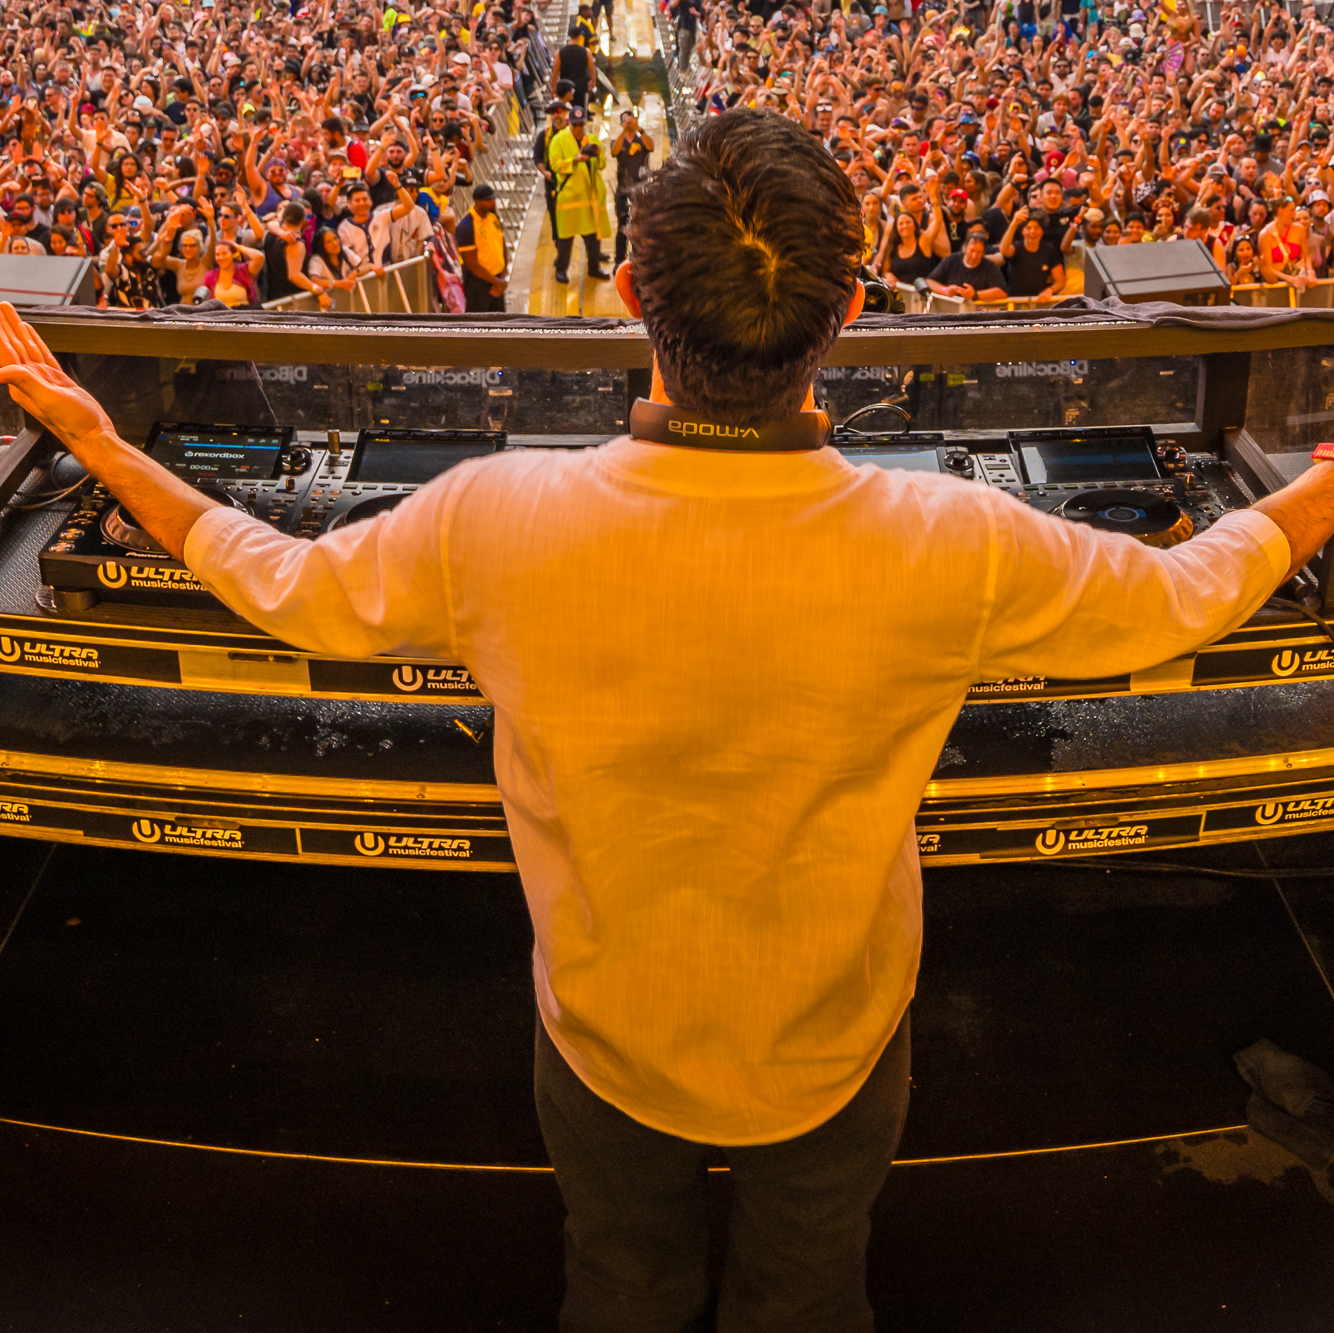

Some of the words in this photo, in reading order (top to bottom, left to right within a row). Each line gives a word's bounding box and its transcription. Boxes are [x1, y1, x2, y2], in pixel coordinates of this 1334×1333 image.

[193, 452, 245, 460] rekordbox
[130, 566, 200, 581] ULTR
[131, 579, 208, 591] musicfestiva
[23, 642, 99, 660] ULTRA
[164, 824, 242, 840] ULTRA
[1068, 825, 1148, 841] ULTRA
[388, 836, 471, 849] ULTRA
